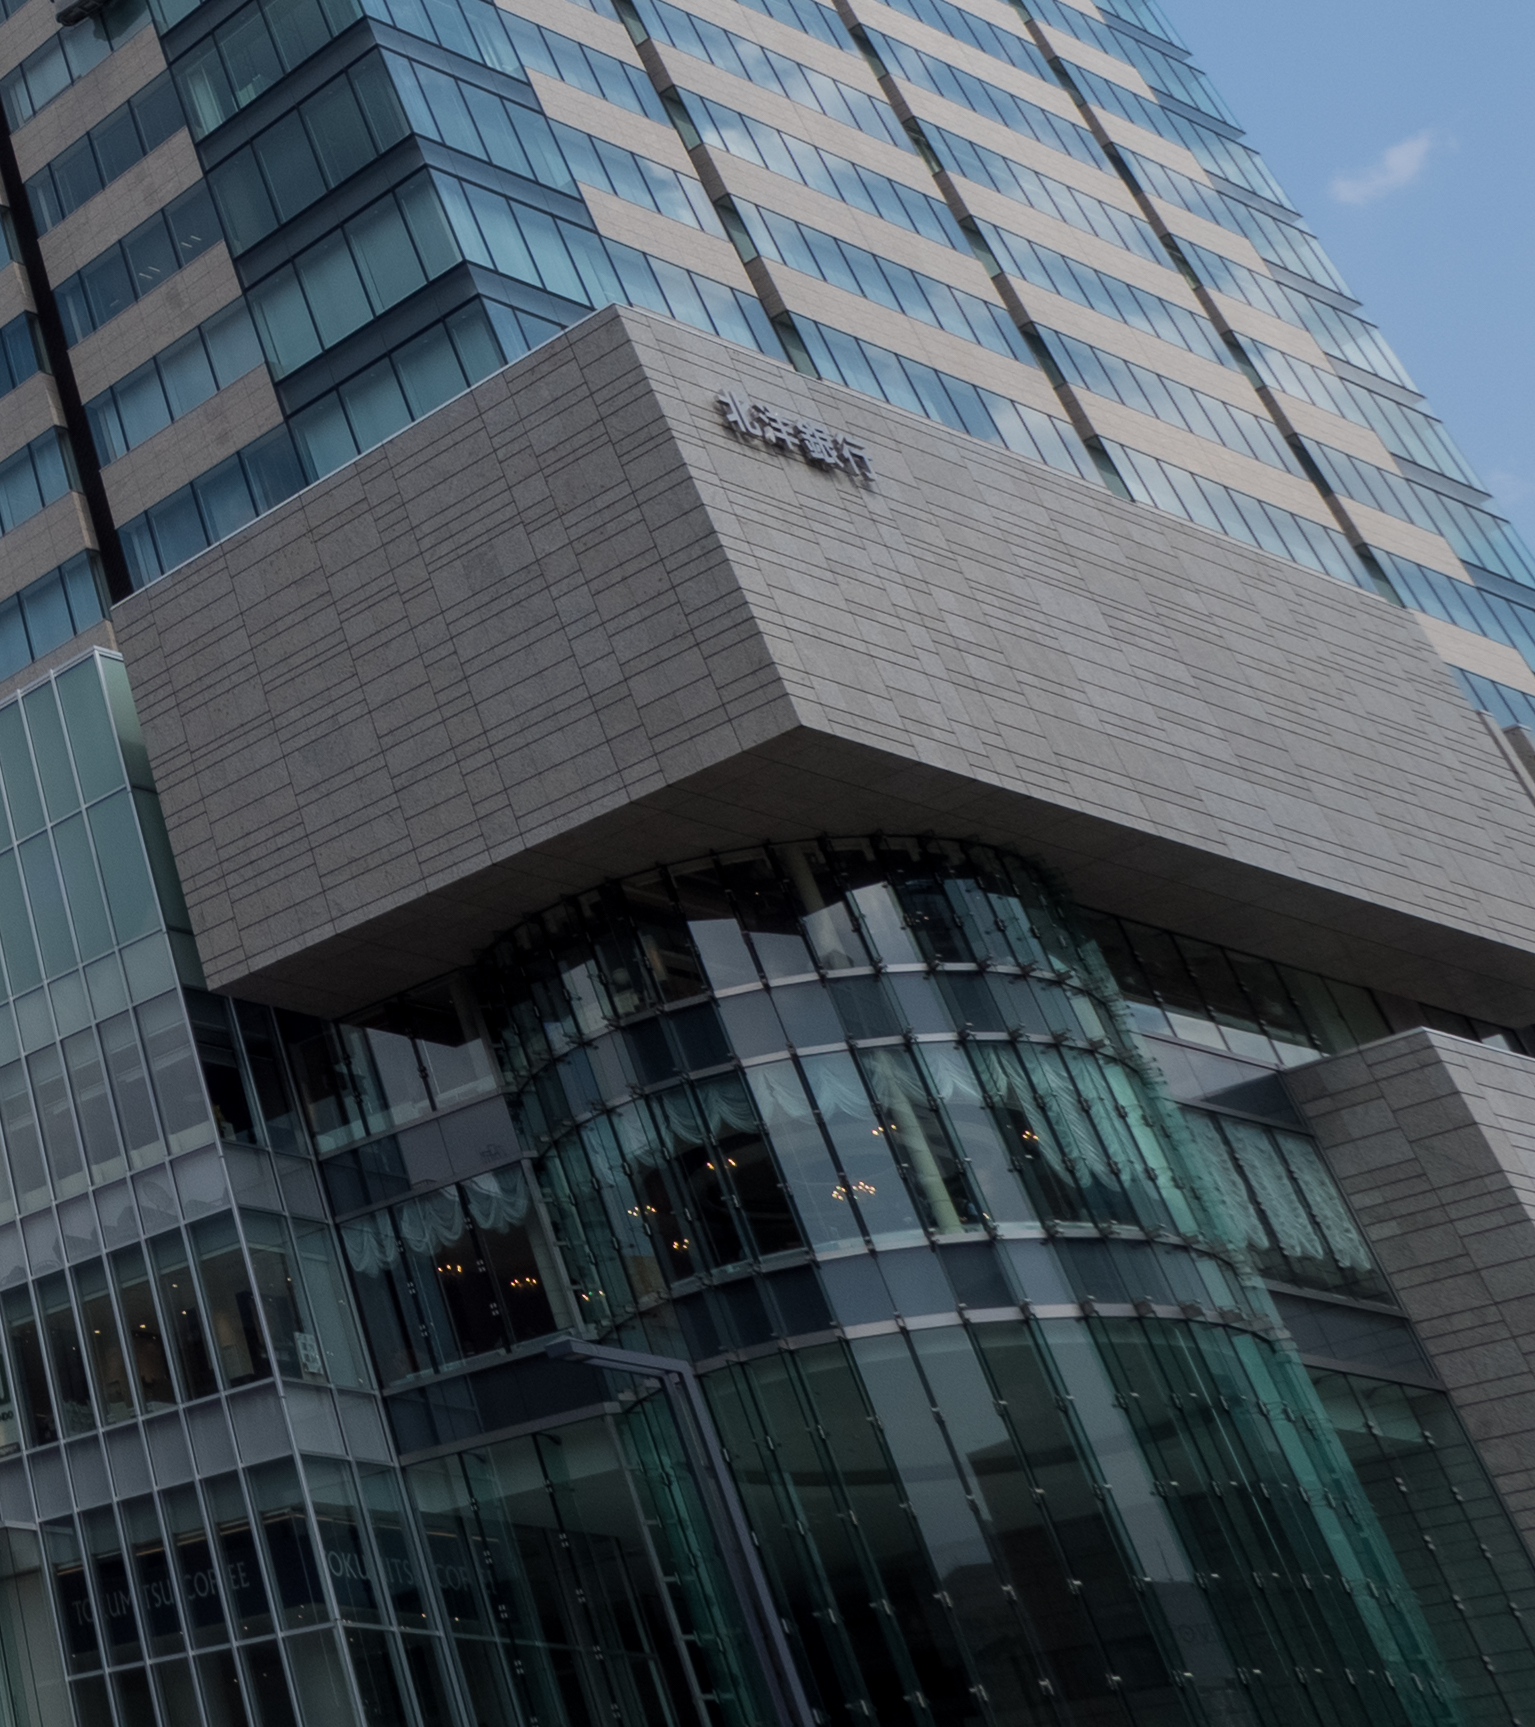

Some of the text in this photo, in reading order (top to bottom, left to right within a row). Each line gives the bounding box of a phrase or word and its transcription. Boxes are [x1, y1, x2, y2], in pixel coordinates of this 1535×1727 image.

[714, 388, 877, 482] 北洋銀行
[181, 1561, 250, 1601] COFEE
